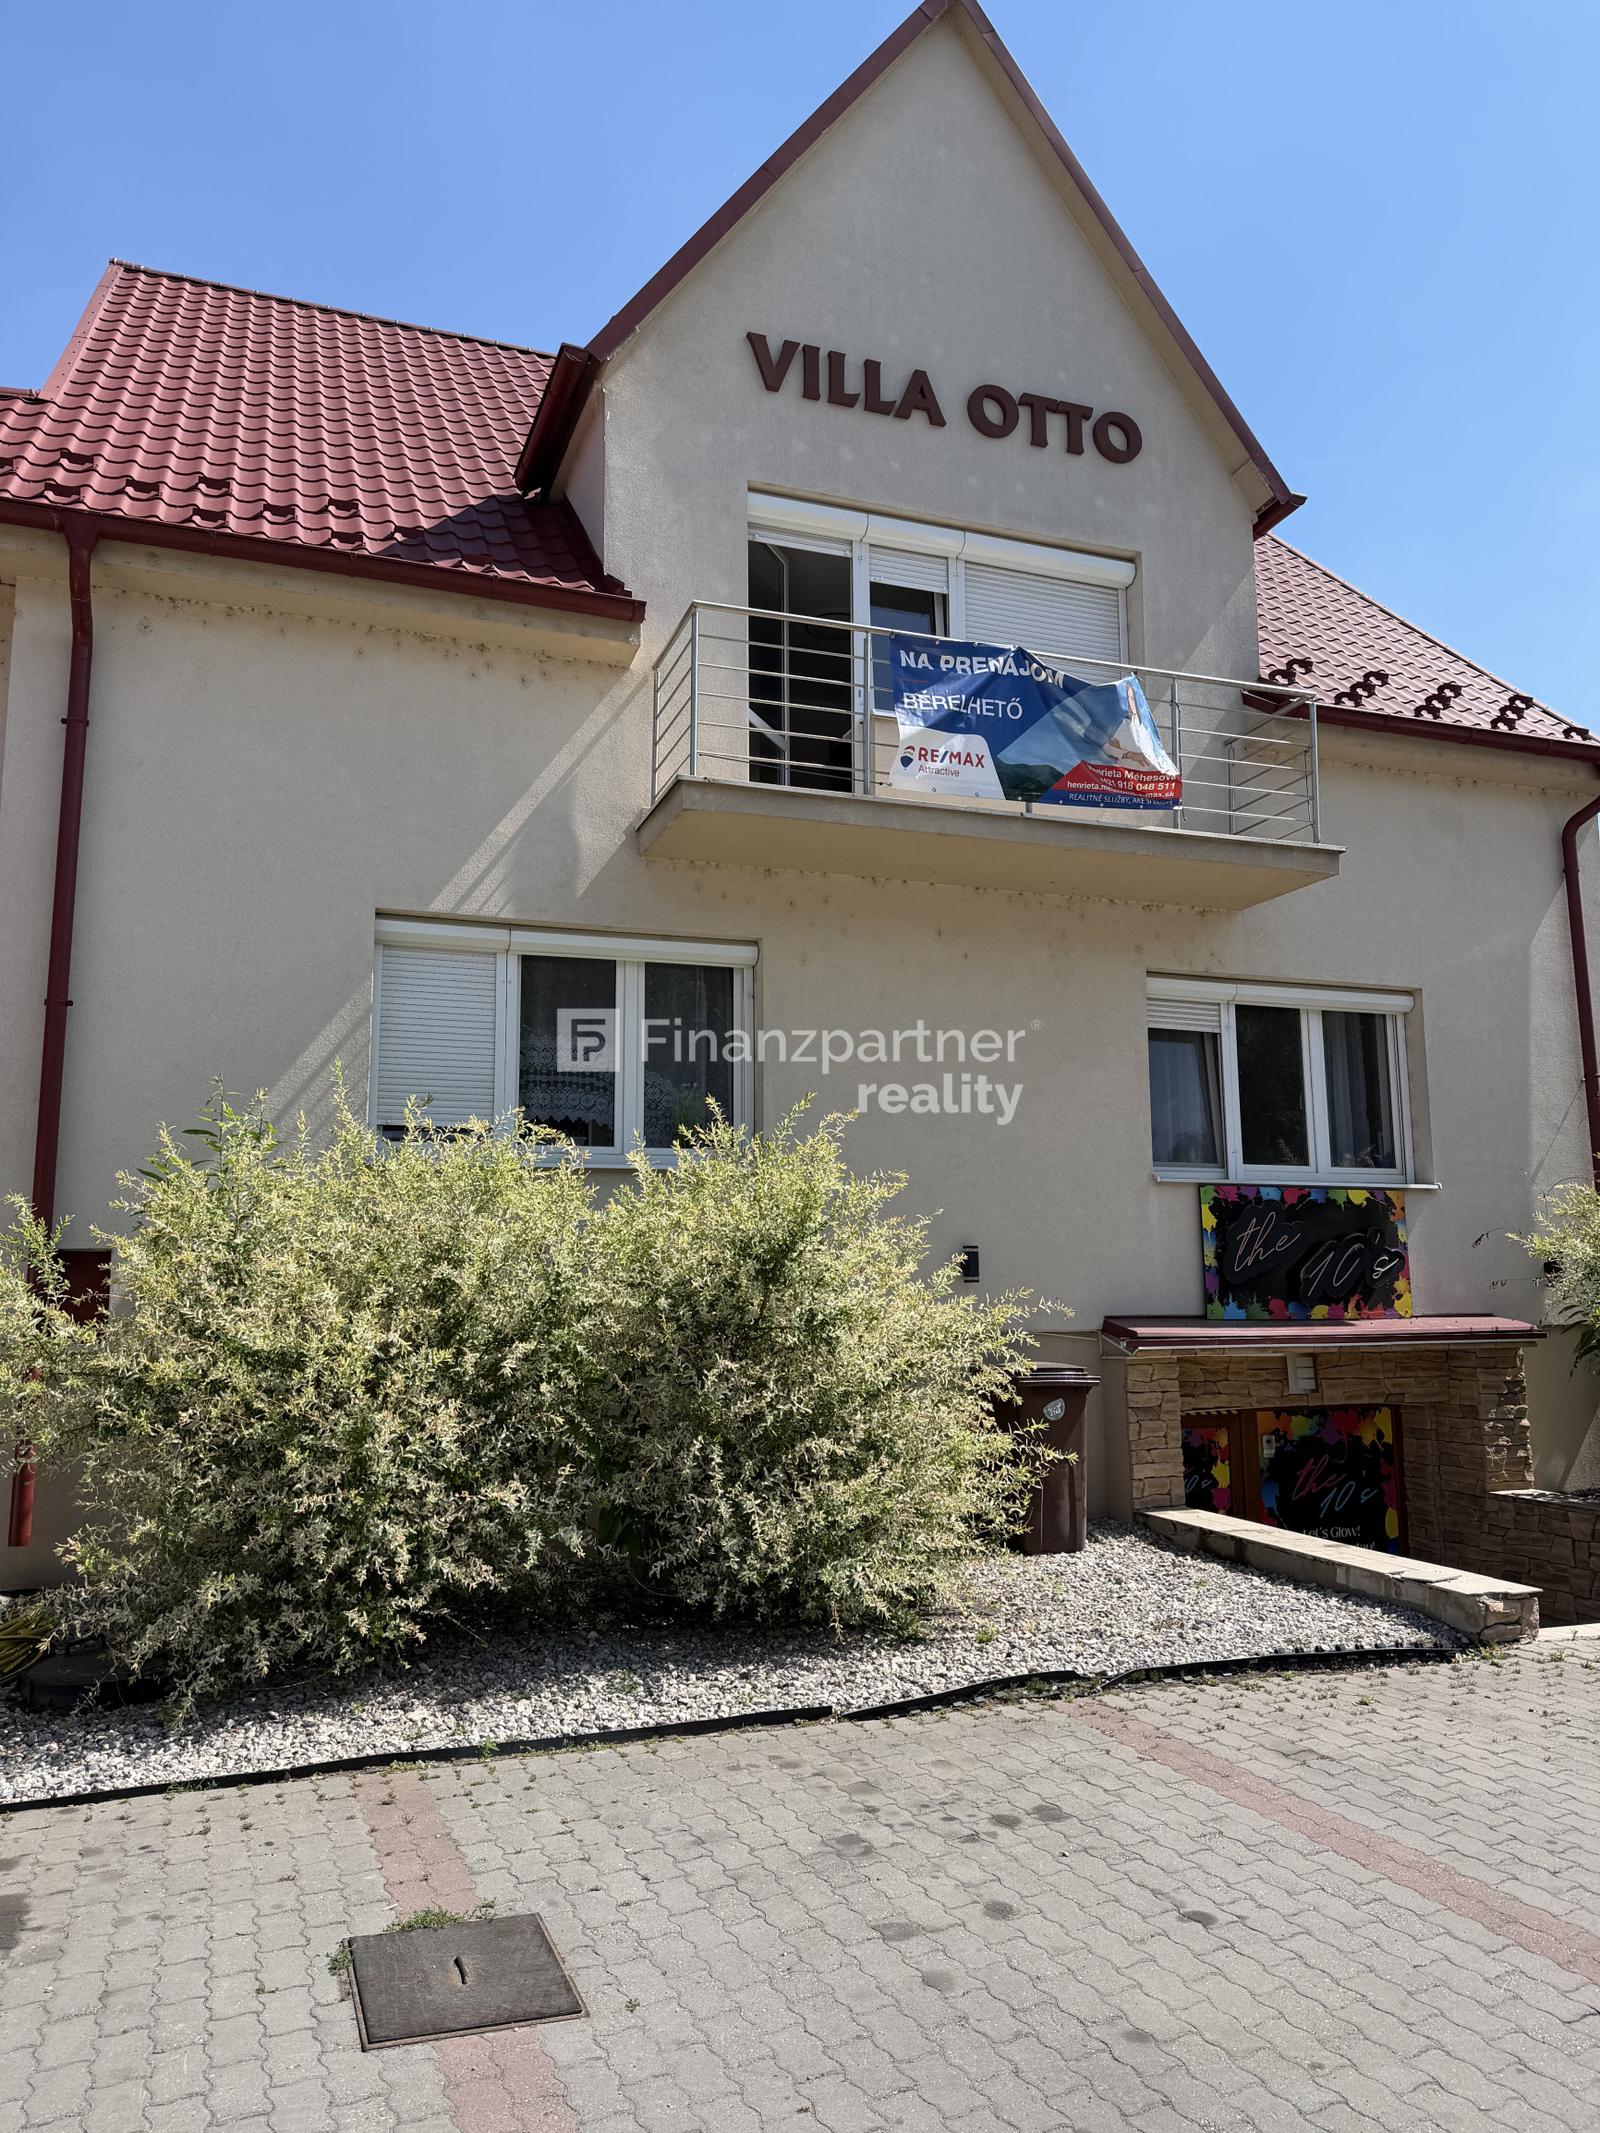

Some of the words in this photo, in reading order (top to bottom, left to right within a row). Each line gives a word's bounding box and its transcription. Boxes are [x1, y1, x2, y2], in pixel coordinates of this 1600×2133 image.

[746, 331, 947, 428] VILLA
[967, 384, 1143, 464] OTTO
[900, 650, 934, 670] NA
[903, 690, 1023, 720] BÉRELHETŐ
[918, 747, 985, 768] RE/MAX
[918, 765, 960, 777] Attractive
[1117, 781, 1134, 790] 918
[1136, 783, 1155, 792] 048
[1157, 782, 1176, 791] 511
[1234, 1211, 1301, 1272] the
[1291, 1454, 1347, 1501] the
[1330, 1526, 1361, 1539] Glow!
